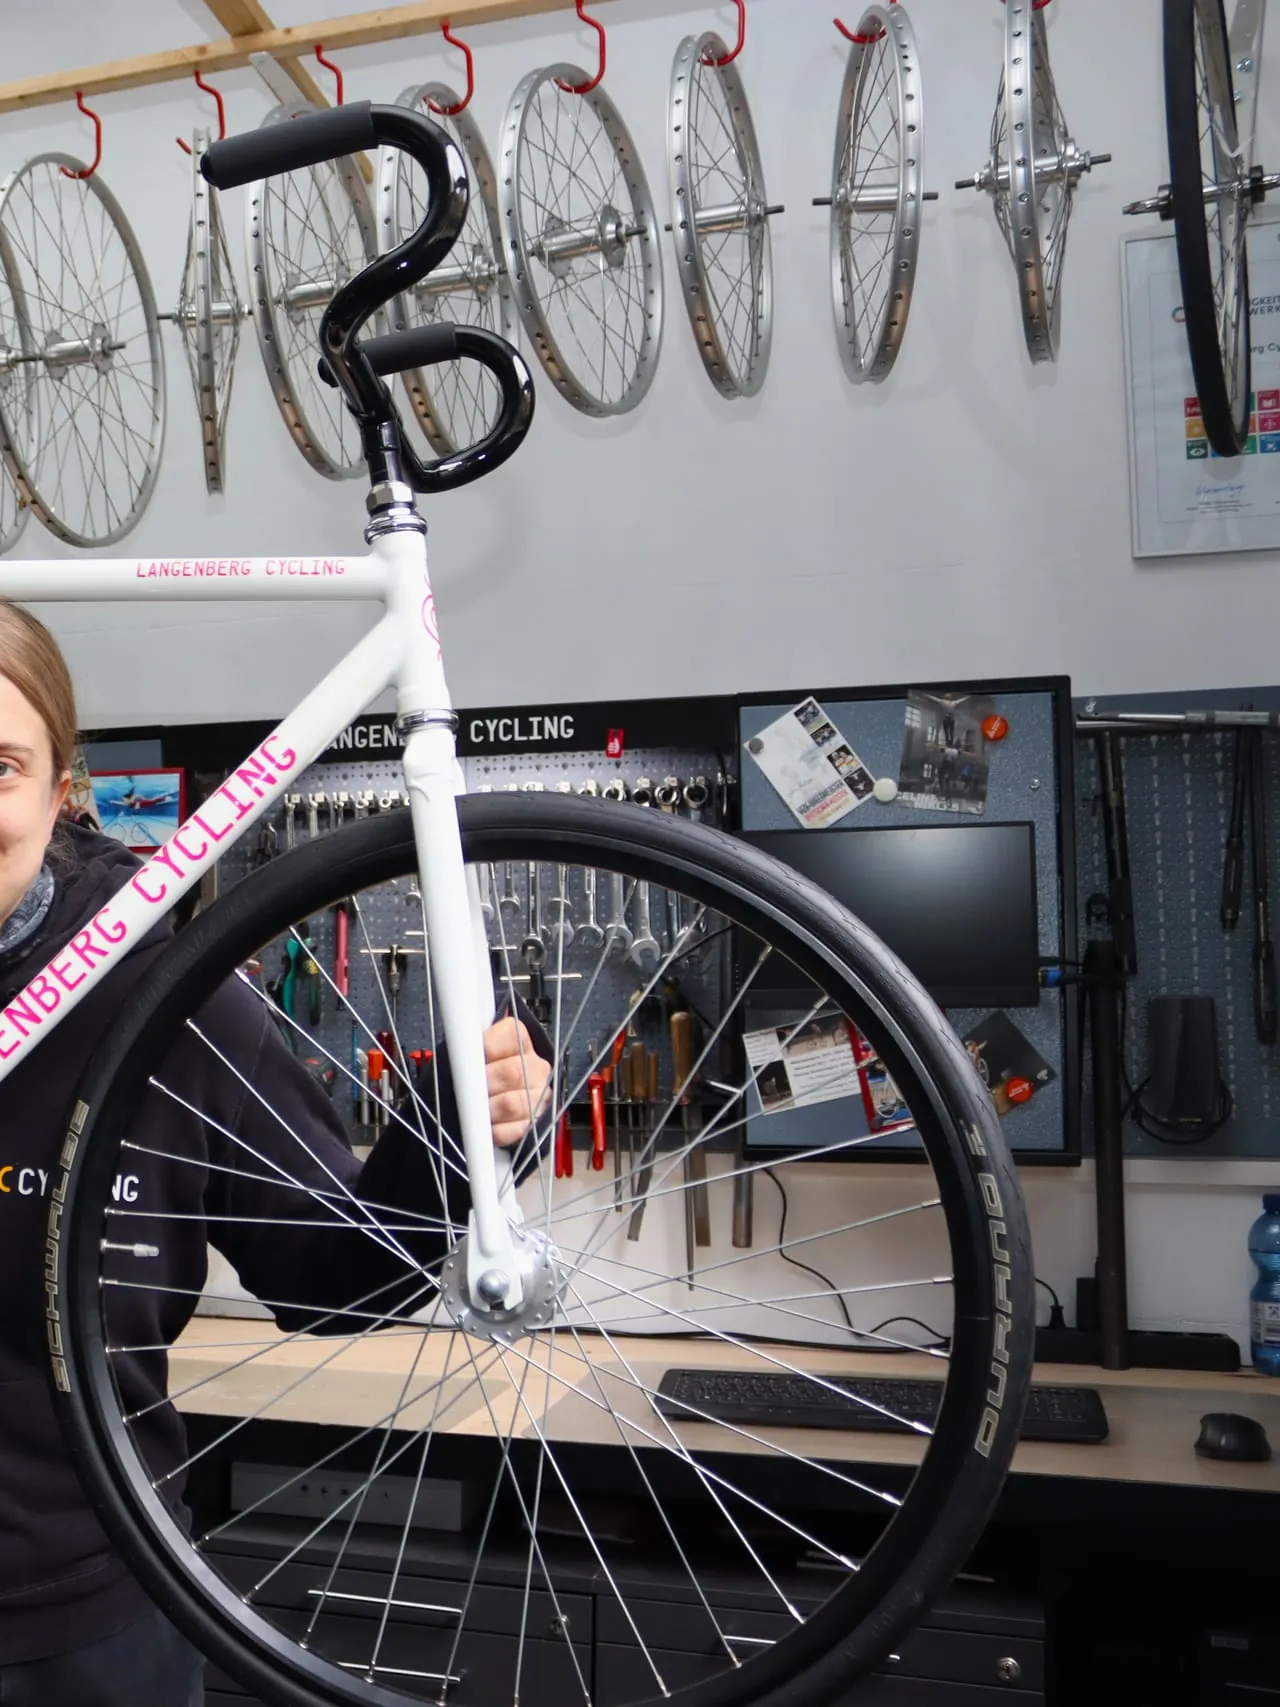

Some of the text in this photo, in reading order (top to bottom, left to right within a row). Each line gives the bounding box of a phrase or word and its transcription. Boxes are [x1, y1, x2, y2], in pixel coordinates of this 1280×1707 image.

[136, 559, 346, 578] LANGENBERG CYCLING
[470, 715, 574, 743] CYCLING
[132, 735, 297, 903] CYCLING
[45, 1099, 89, 1392] SCHWALBE
[974, 1173, 1012, 1458] DURANO
